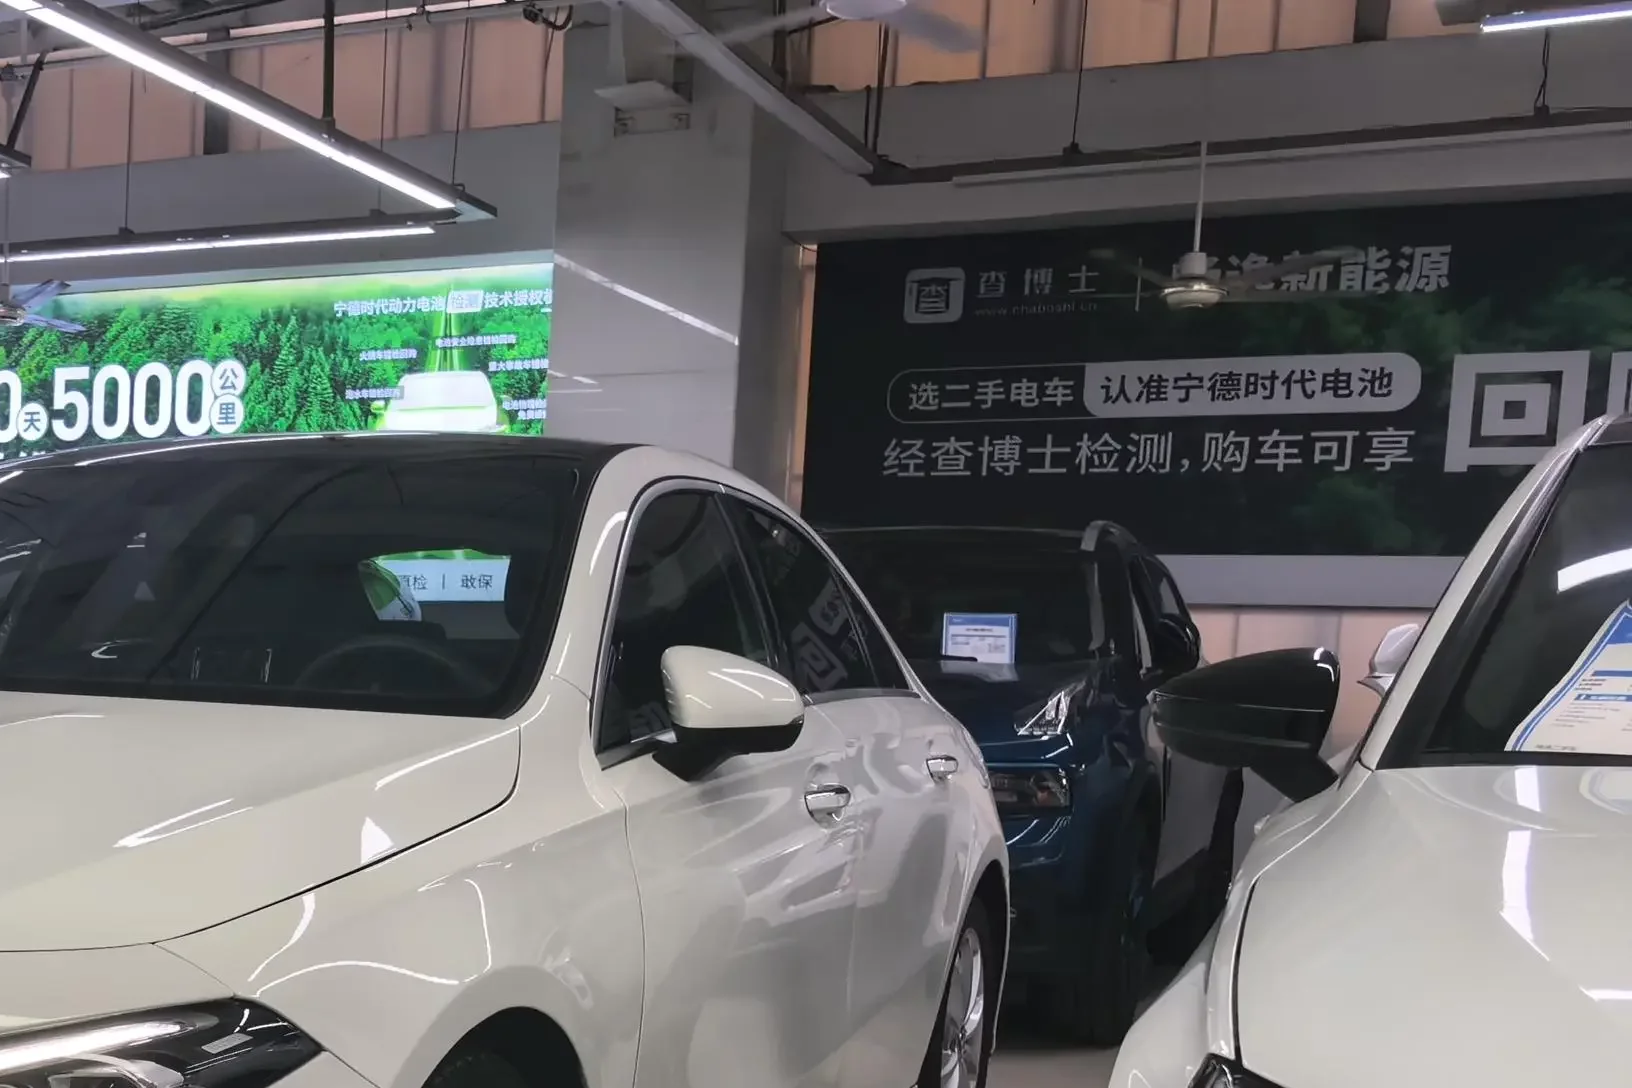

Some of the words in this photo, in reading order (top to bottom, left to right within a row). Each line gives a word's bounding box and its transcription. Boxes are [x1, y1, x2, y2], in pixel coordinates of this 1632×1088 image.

[976, 265, 1100, 298] 查博士
[908, 377, 1075, 411] 选二手电车
[1100, 366, 1393, 405] 认准宁德时代电池
[461, 573, 493, 589] 敢保
